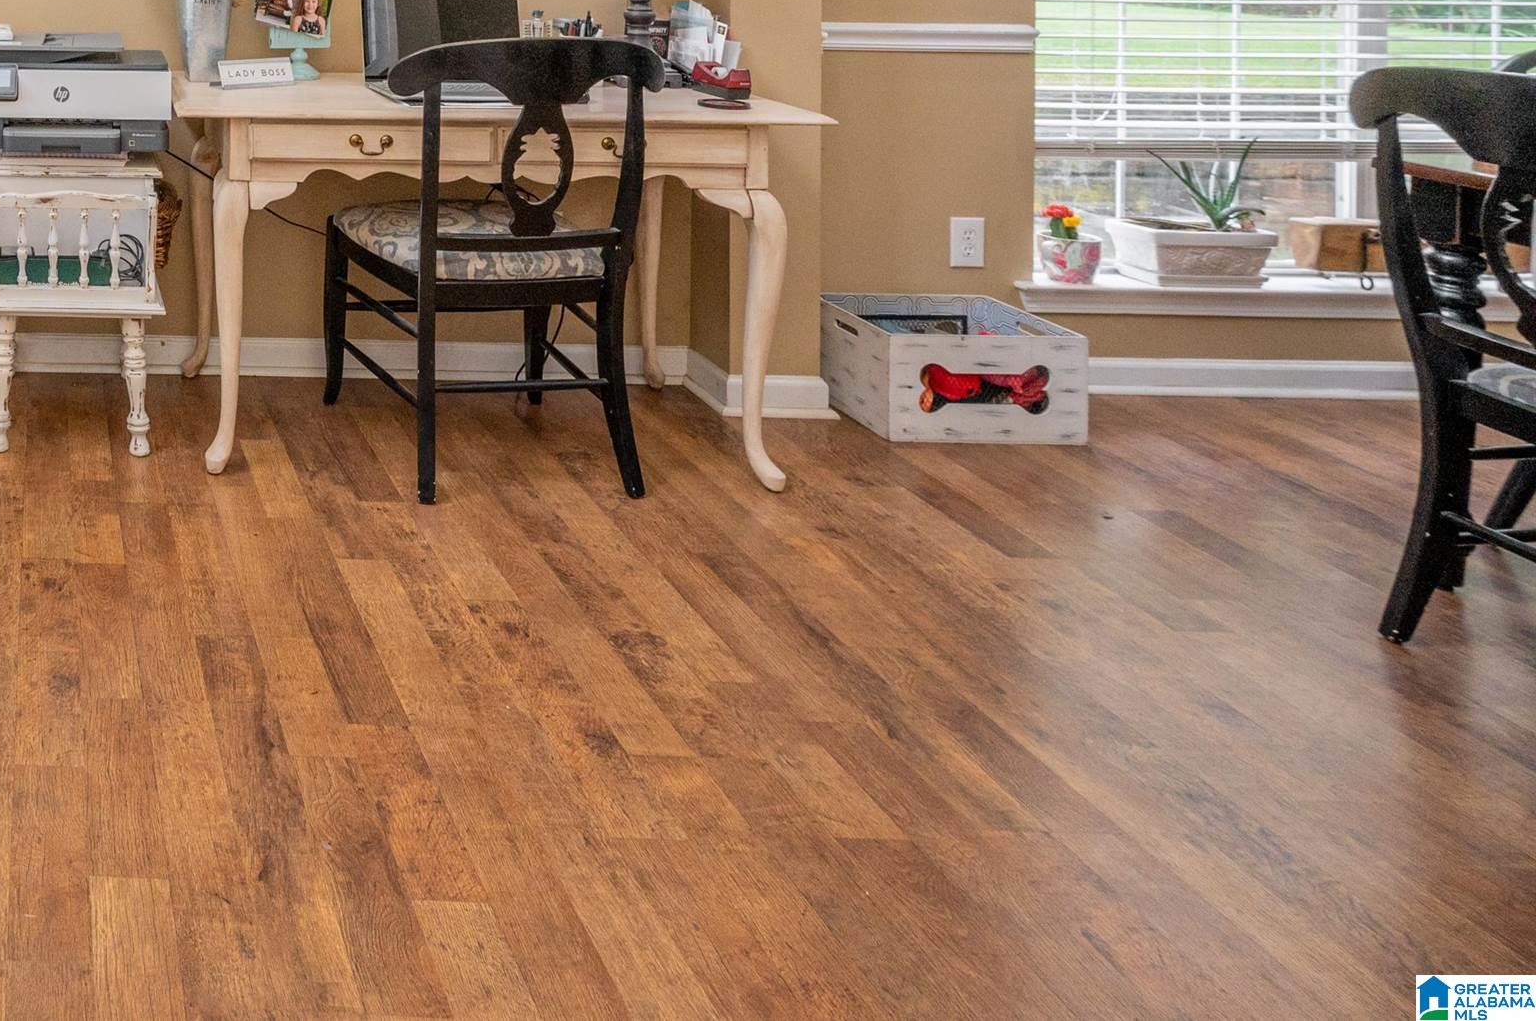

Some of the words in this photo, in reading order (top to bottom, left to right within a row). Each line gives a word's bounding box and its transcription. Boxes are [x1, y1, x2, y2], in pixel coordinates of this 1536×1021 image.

[227, 69, 256, 78] LADY
[260, 68, 286, 77] BOSS
[54, 86, 69, 102] hp
